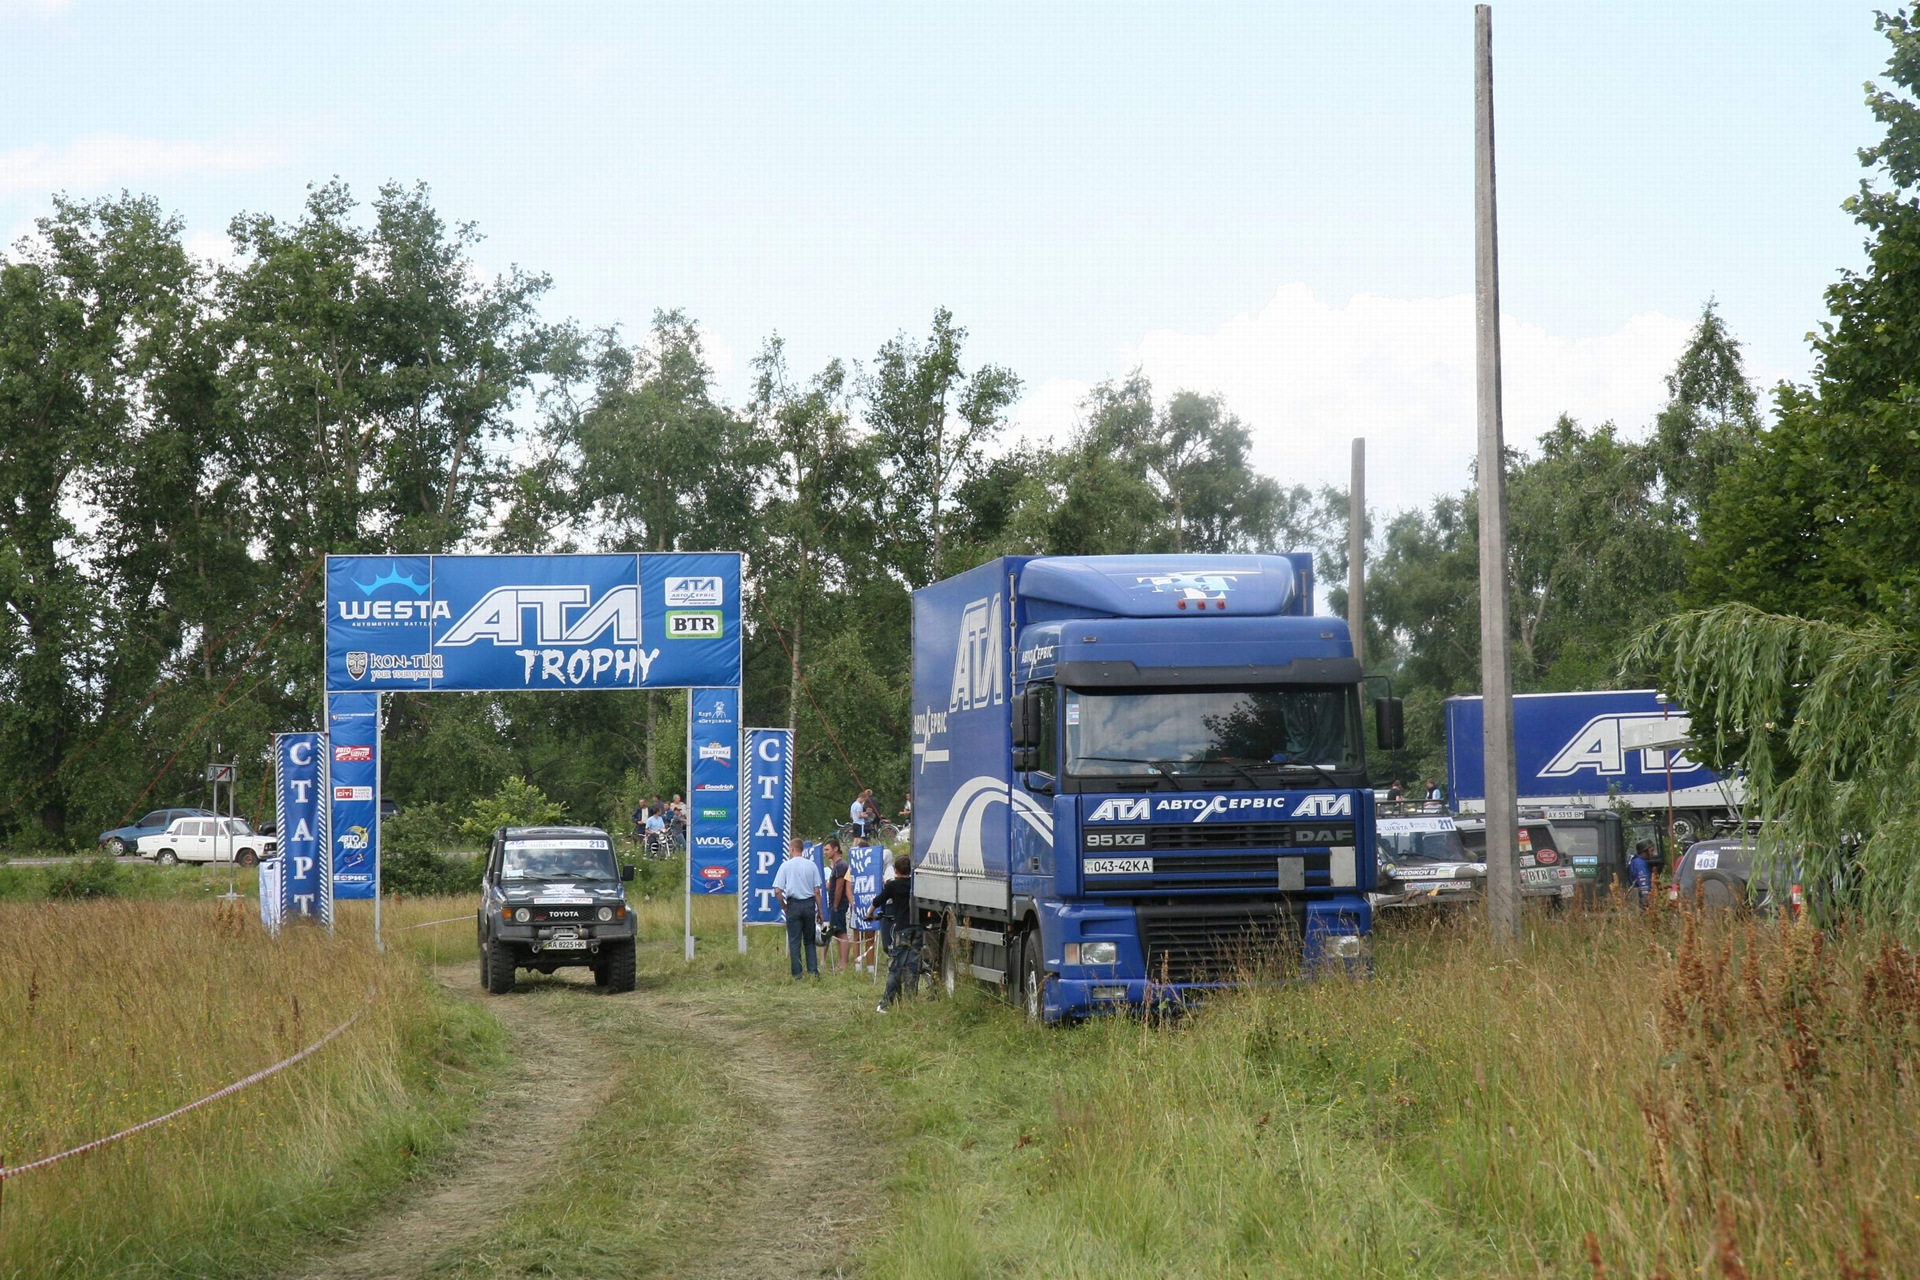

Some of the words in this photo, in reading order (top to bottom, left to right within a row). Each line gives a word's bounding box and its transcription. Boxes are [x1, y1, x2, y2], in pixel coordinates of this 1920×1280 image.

[338, 600, 452, 620] WESTA
[672, 617, 716, 632] BTR
[370, 653, 444, 669] KON-TIKI
[515, 648, 660, 685] TROPHY
[289, 741, 314, 916] СТАРТ
[755, 738, 780, 912] СТАРТ
[1438, 820, 1454, 830] 211
[695, 836, 730, 845] WOLF
[1086, 834, 1113, 847] 95
[1116, 834, 1145, 846] XF
[1295, 829, 1353, 842] DAF
[589, 840, 605, 849] 213
[1697, 858, 1716, 868] 403
[1528, 868, 1548, 881] BTR
